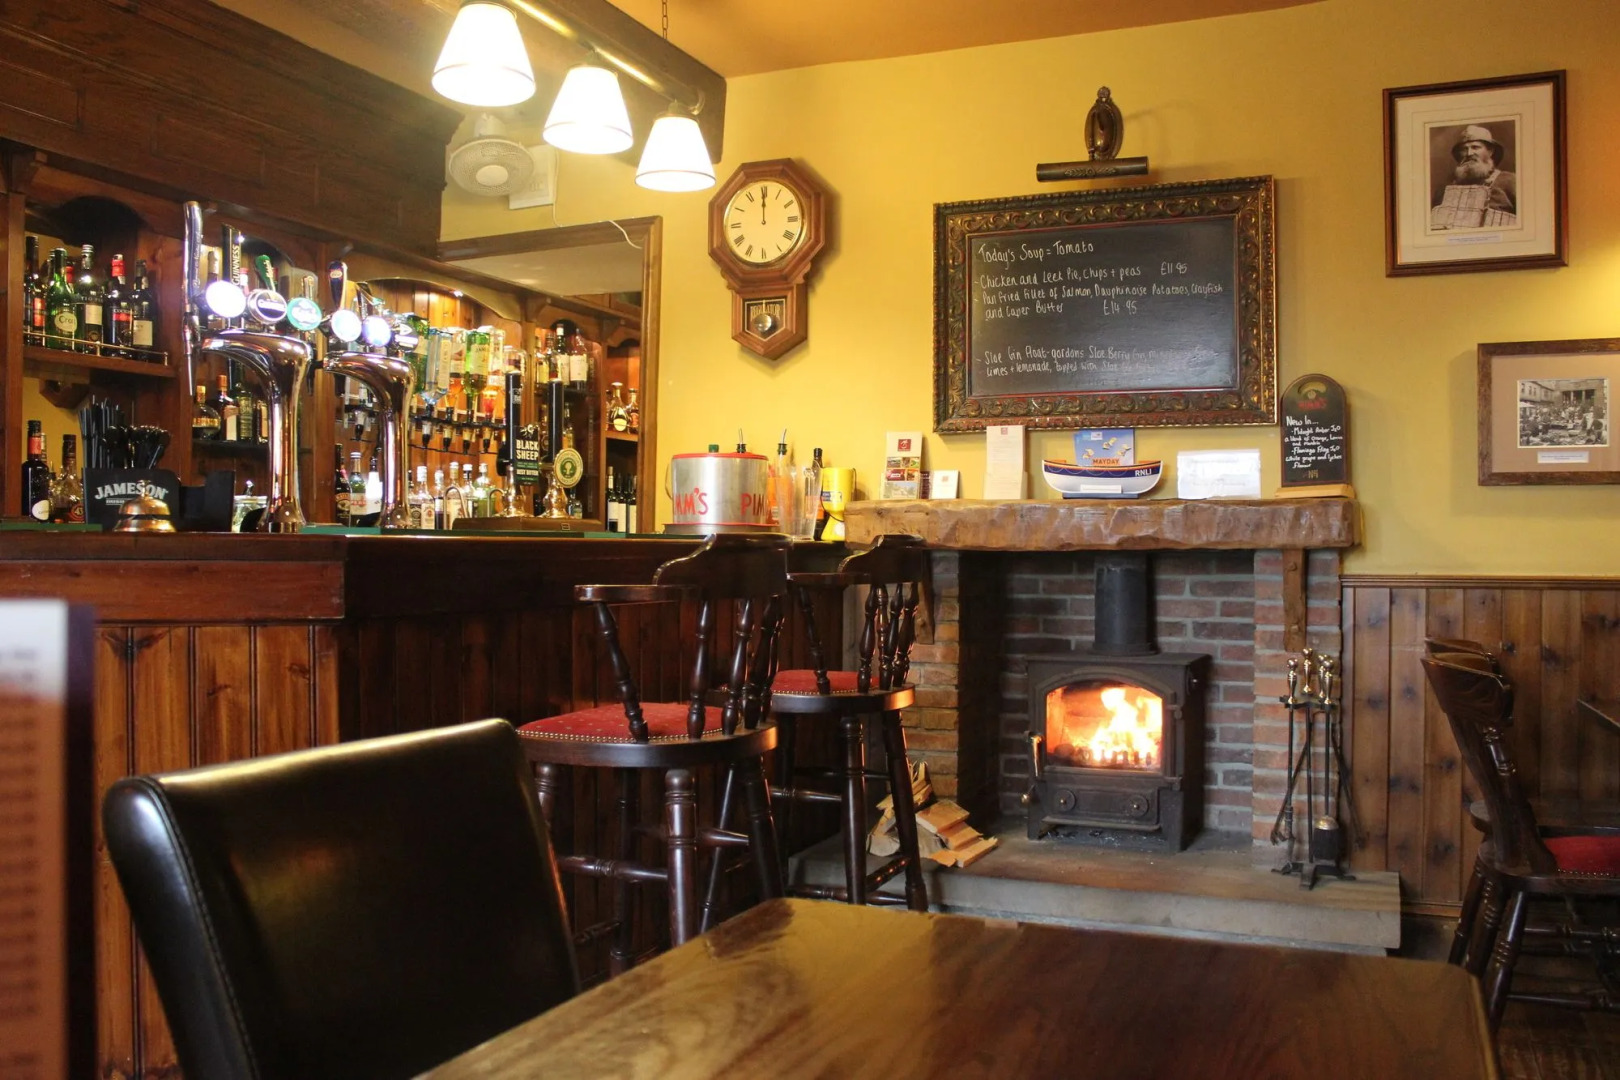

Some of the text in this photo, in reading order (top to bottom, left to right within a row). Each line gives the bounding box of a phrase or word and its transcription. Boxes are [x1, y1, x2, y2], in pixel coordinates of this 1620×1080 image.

[231, 243, 240, 286] GUINNESS
[978, 243, 1015, 271] Today's
[1020, 243, 1043, 262] Soup
[1053, 240, 1094, 256] Tomato
[980, 274, 1018, 290] Chicken
[1019, 272, 1038, 286] and
[1042, 270, 1064, 283] Leek
[1066, 266, 1082, 281] Pie,
[1119, 266, 1141, 281] peas
[982, 290, 997, 305] Pan
[999, 291, 1020, 304] fried
[1049, 286, 1059, 300] of
[1094, 283, 1147, 299] Dauphinoise
[985, 307, 1003, 320] and
[1005, 305, 1030, 318] Caper
[1035, 300, 1064, 314] Butter
[984, 350, 1003, 365] Sloe
[1007, 346, 1022, 361] Gin
[1016, 361, 1052, 374] lemonade,
[1055, 361, 1078, 373] topped
[1080, 361, 1097, 371] with
[1286, 415, 1303, 427] New
[516, 439, 539, 451] BLACK
[516, 450, 539, 461] SHEEP
[1134, 468, 1152, 477] RNLI
[94, 482, 166, 500] JAMESON
